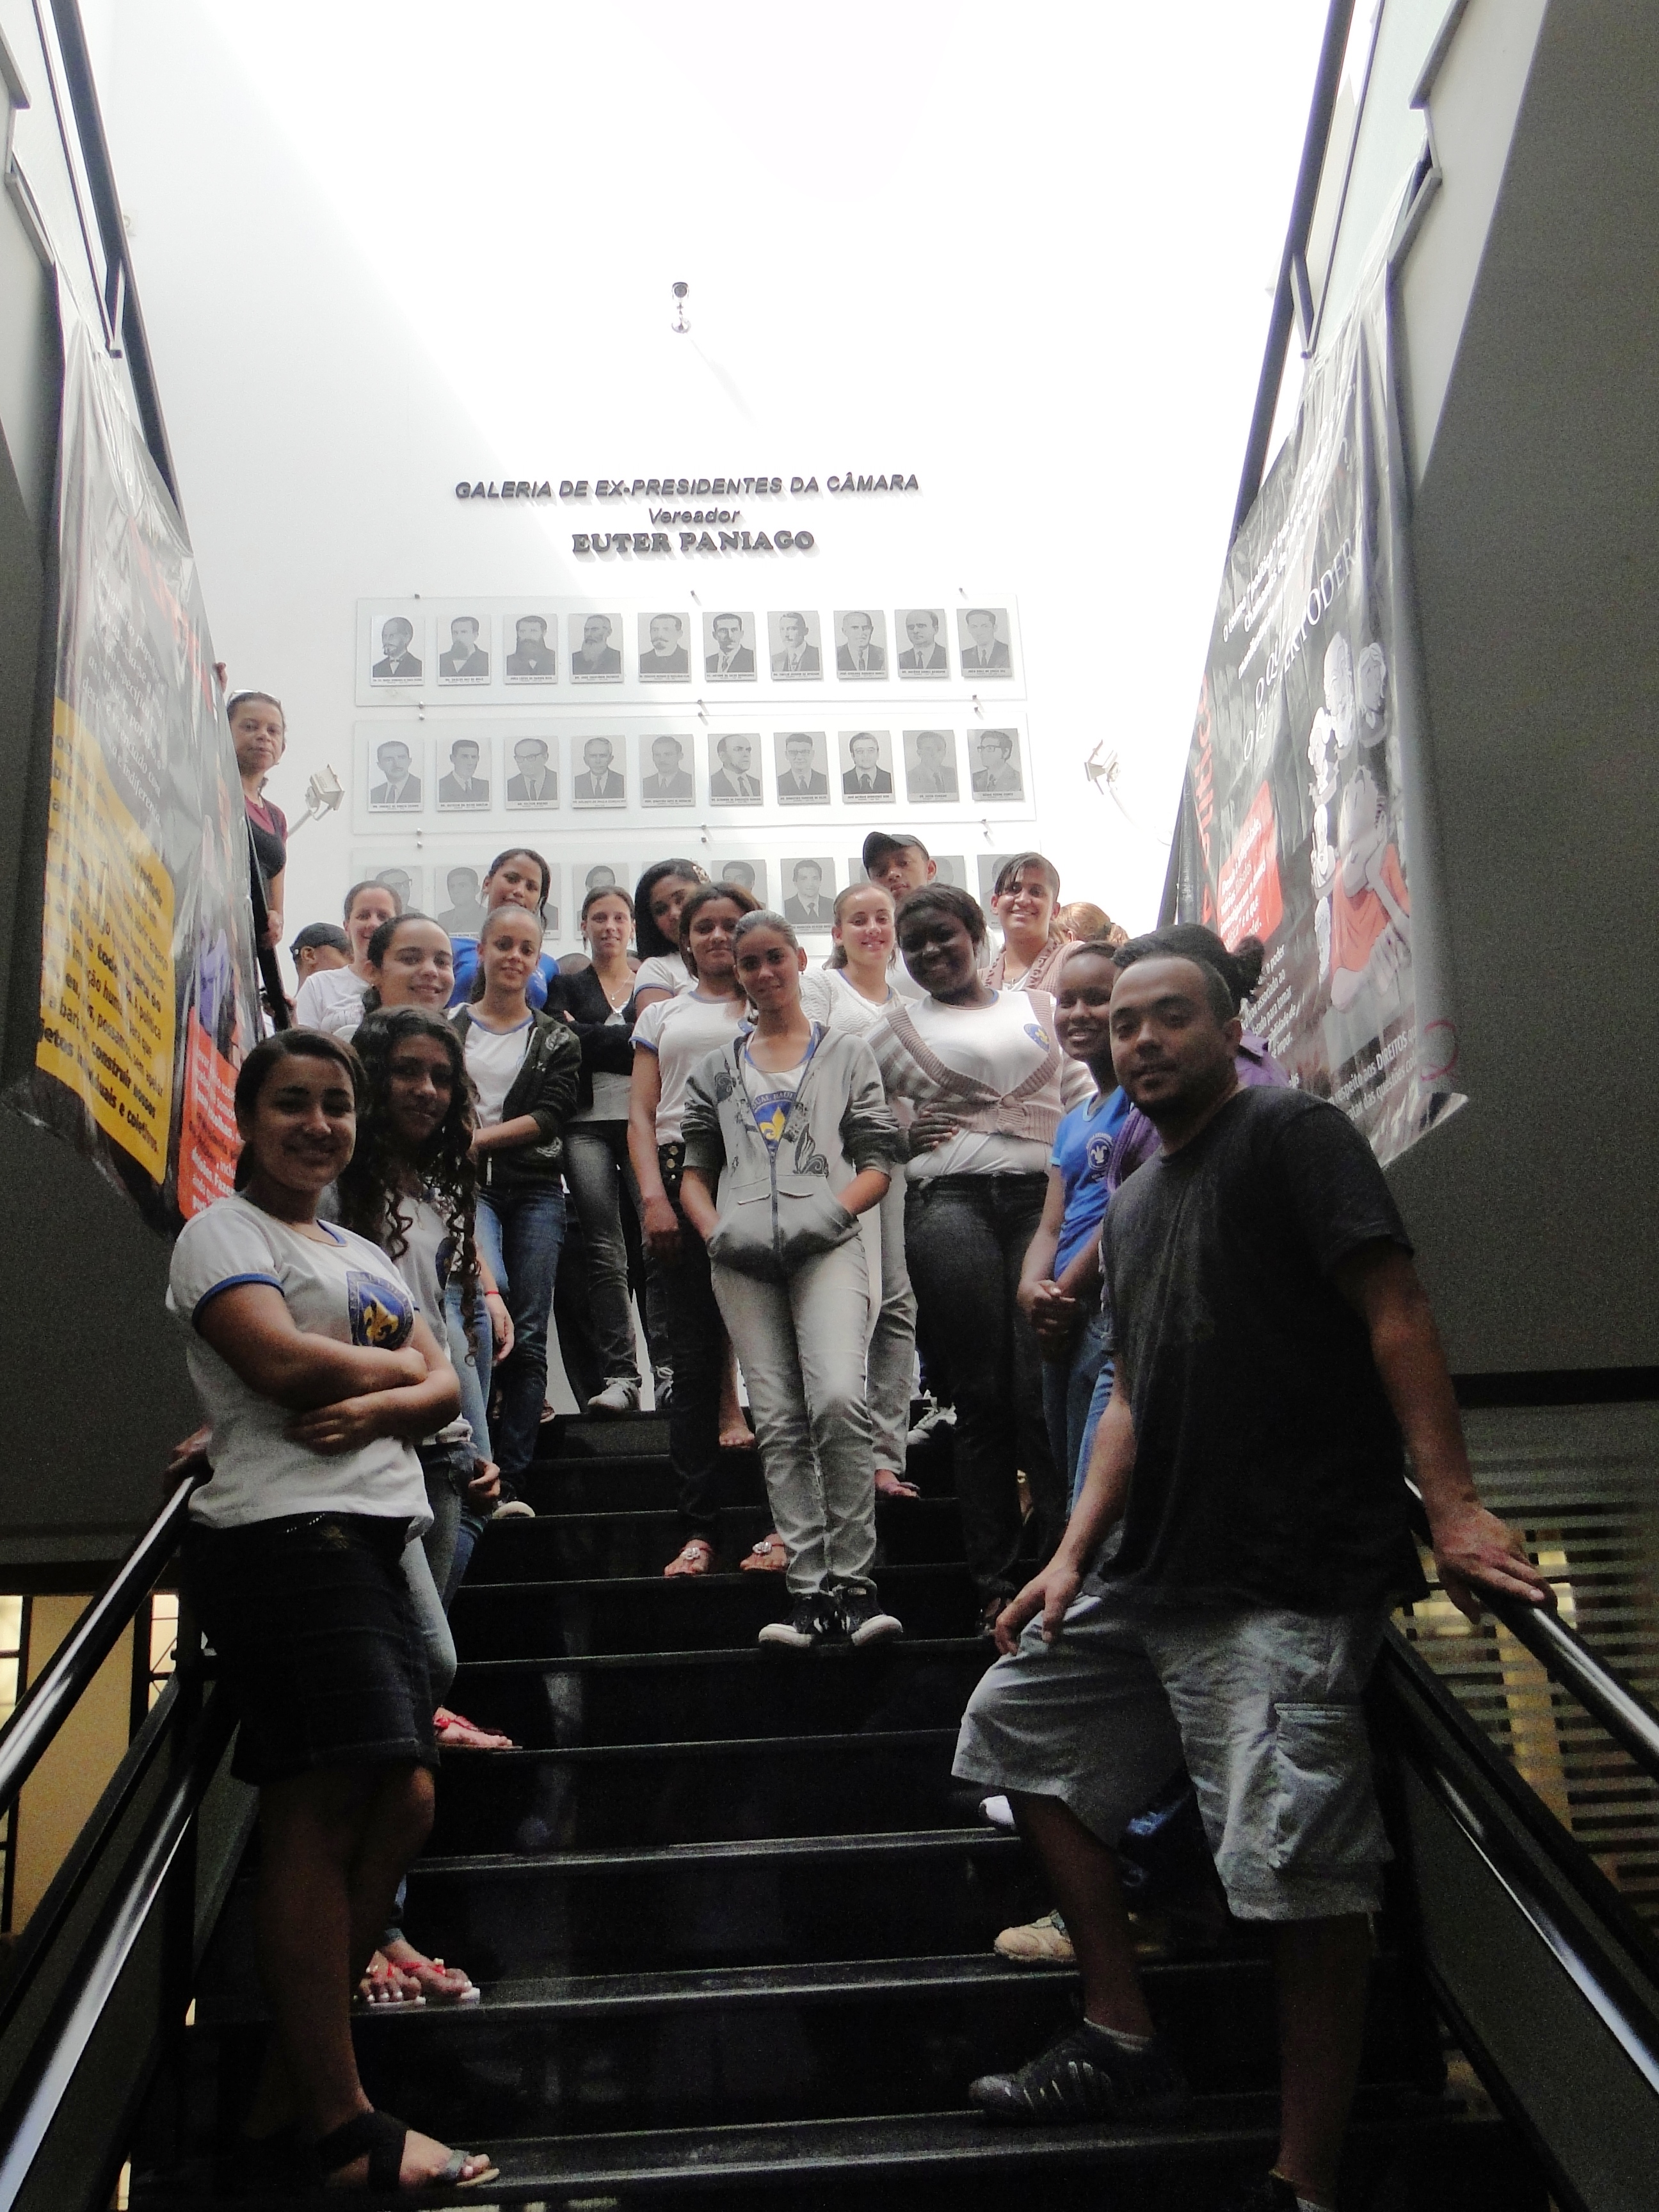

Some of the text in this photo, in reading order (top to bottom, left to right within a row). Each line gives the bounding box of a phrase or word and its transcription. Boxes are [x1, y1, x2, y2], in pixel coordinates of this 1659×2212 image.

[455, 472, 920, 499] GALERIA DE EX-PRESIDENTES DA CÂMARA
[648, 507, 741, 525] Vereador
[572, 530, 815, 553] EUTER PANIAGO
[1255, 677, 1265, 710] O
[1244, 730, 1254, 761] O
[1334, 1073, 1363, 1105] respeito
[1363, 1062, 1377, 1082] aos
[1376, 1030, 1408, 1071] DIREITOS
[1363, 1091, 1376, 1110] das
